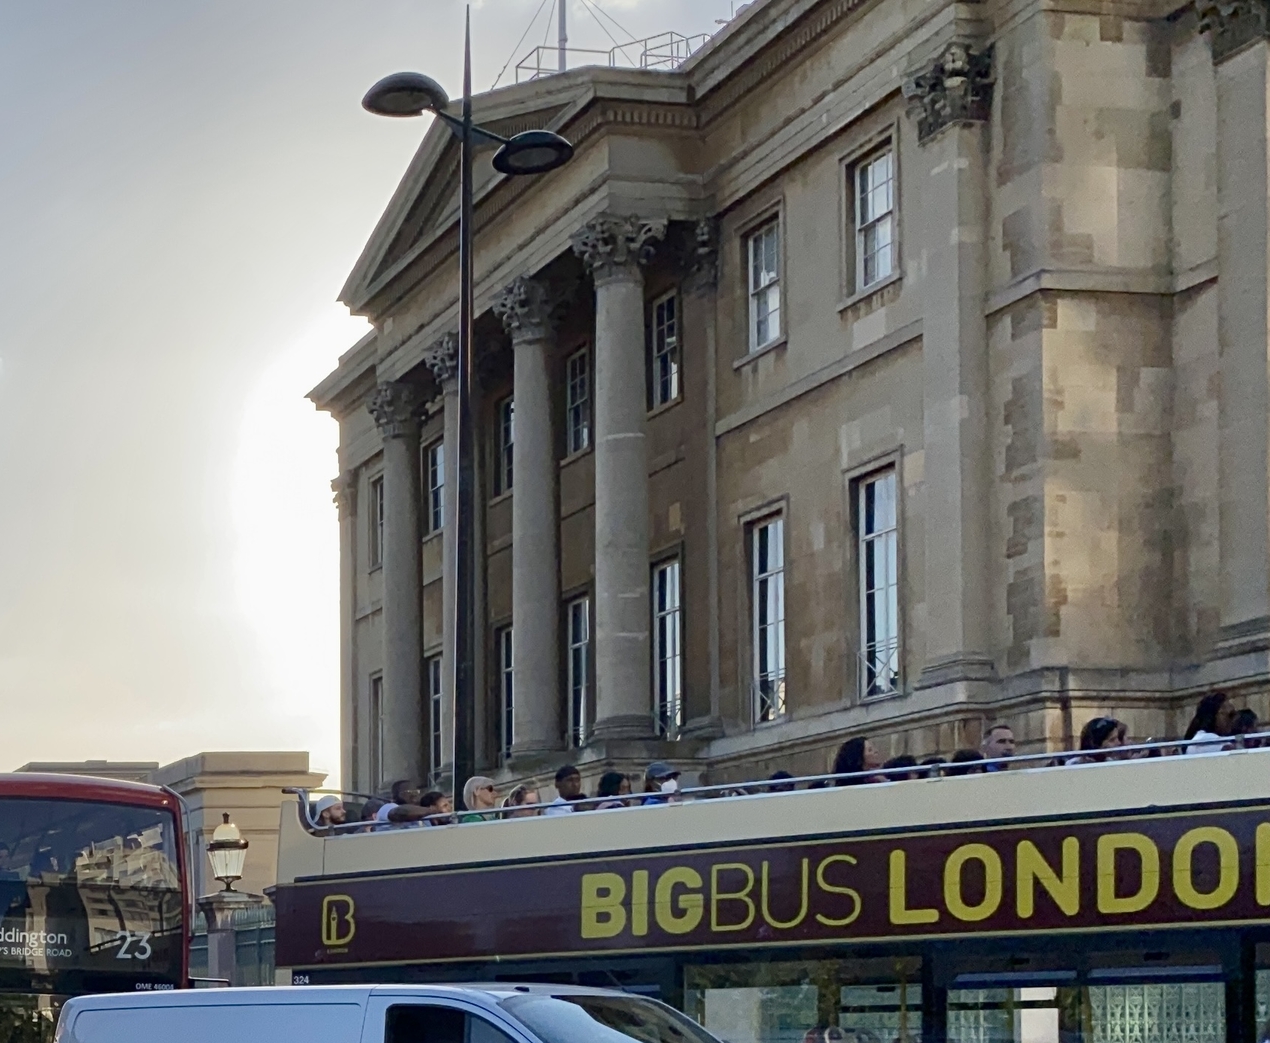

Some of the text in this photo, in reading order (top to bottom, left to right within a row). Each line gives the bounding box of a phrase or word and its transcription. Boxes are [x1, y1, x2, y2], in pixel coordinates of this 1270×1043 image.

[889, 822, 1270, 925] LONDO
[10, 946, 44, 957] BRIDGE
[46, 948, 73, 958] ROAD
[115, 931, 153, 960] 23
[293, 975, 310, 985] 324
